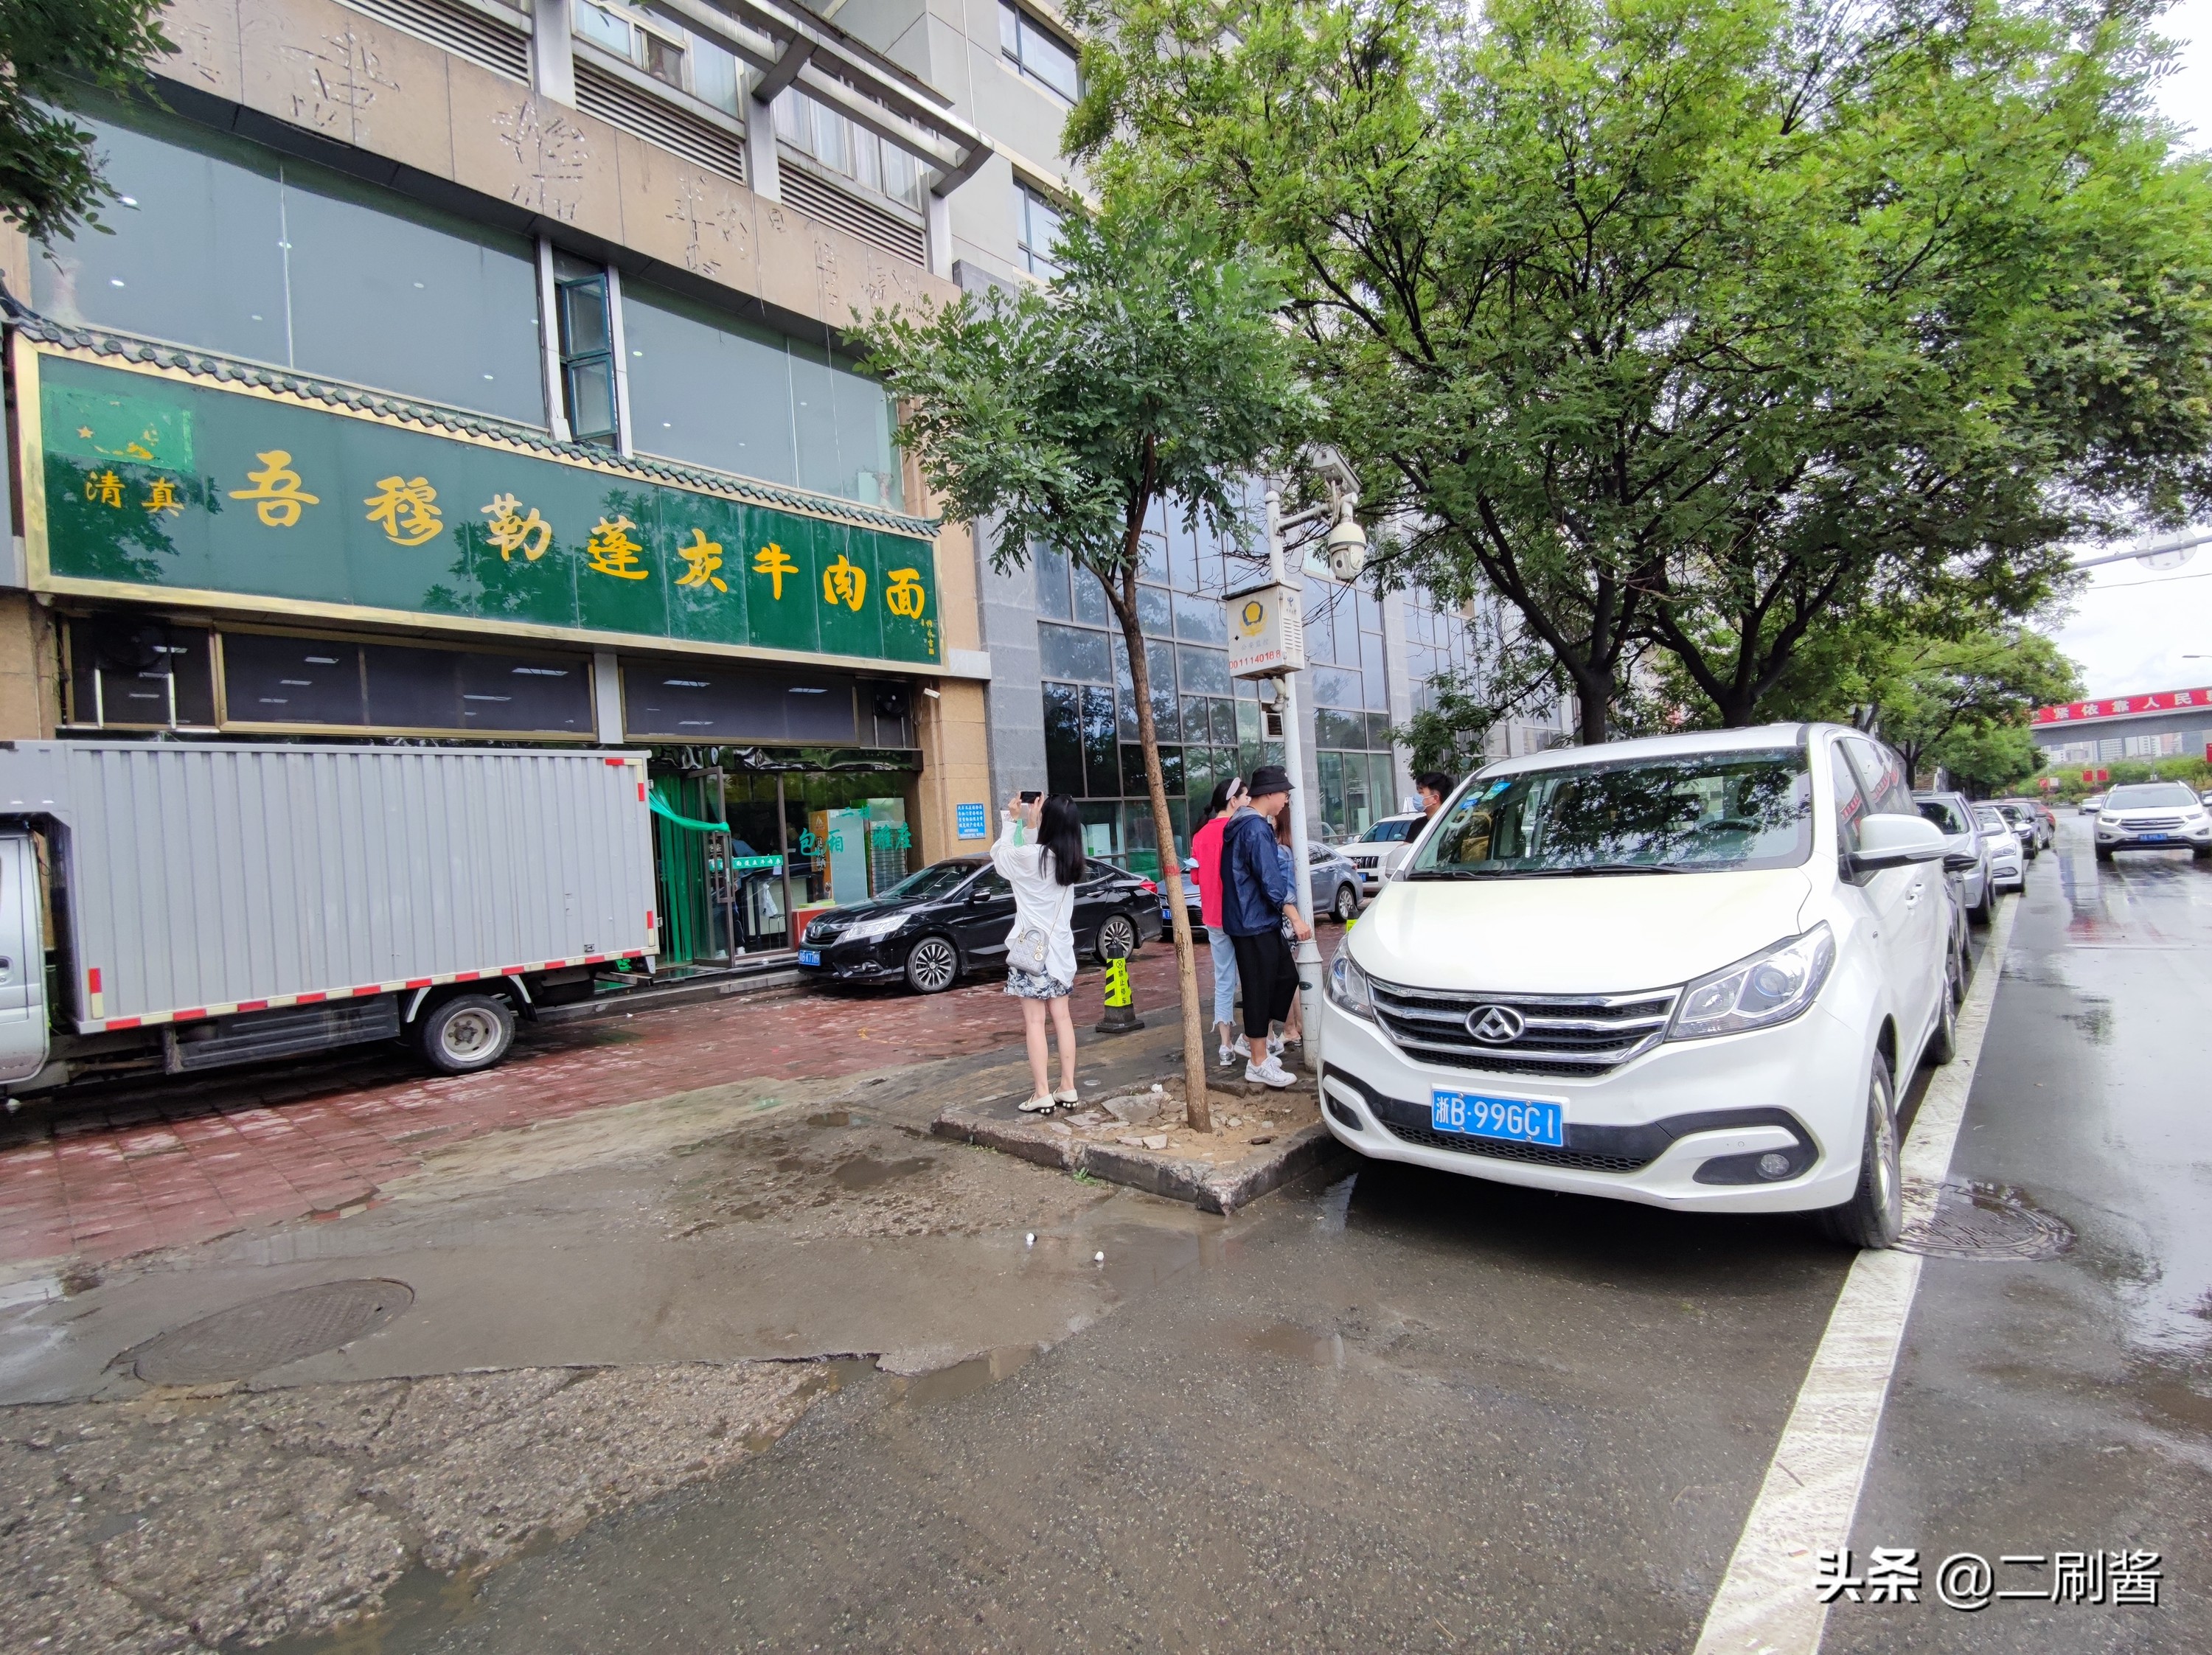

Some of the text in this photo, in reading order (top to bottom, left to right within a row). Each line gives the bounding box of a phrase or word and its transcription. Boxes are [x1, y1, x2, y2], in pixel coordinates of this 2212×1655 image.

[85, 470, 184, 517] 清真
[231, 450, 925, 620] 吾穆勒蓬灰牛肉面
[799, 828, 844, 857] 包厢
[872, 822, 912, 850] 雅座
[1119, 969, 1127, 1004] 禁止停车
